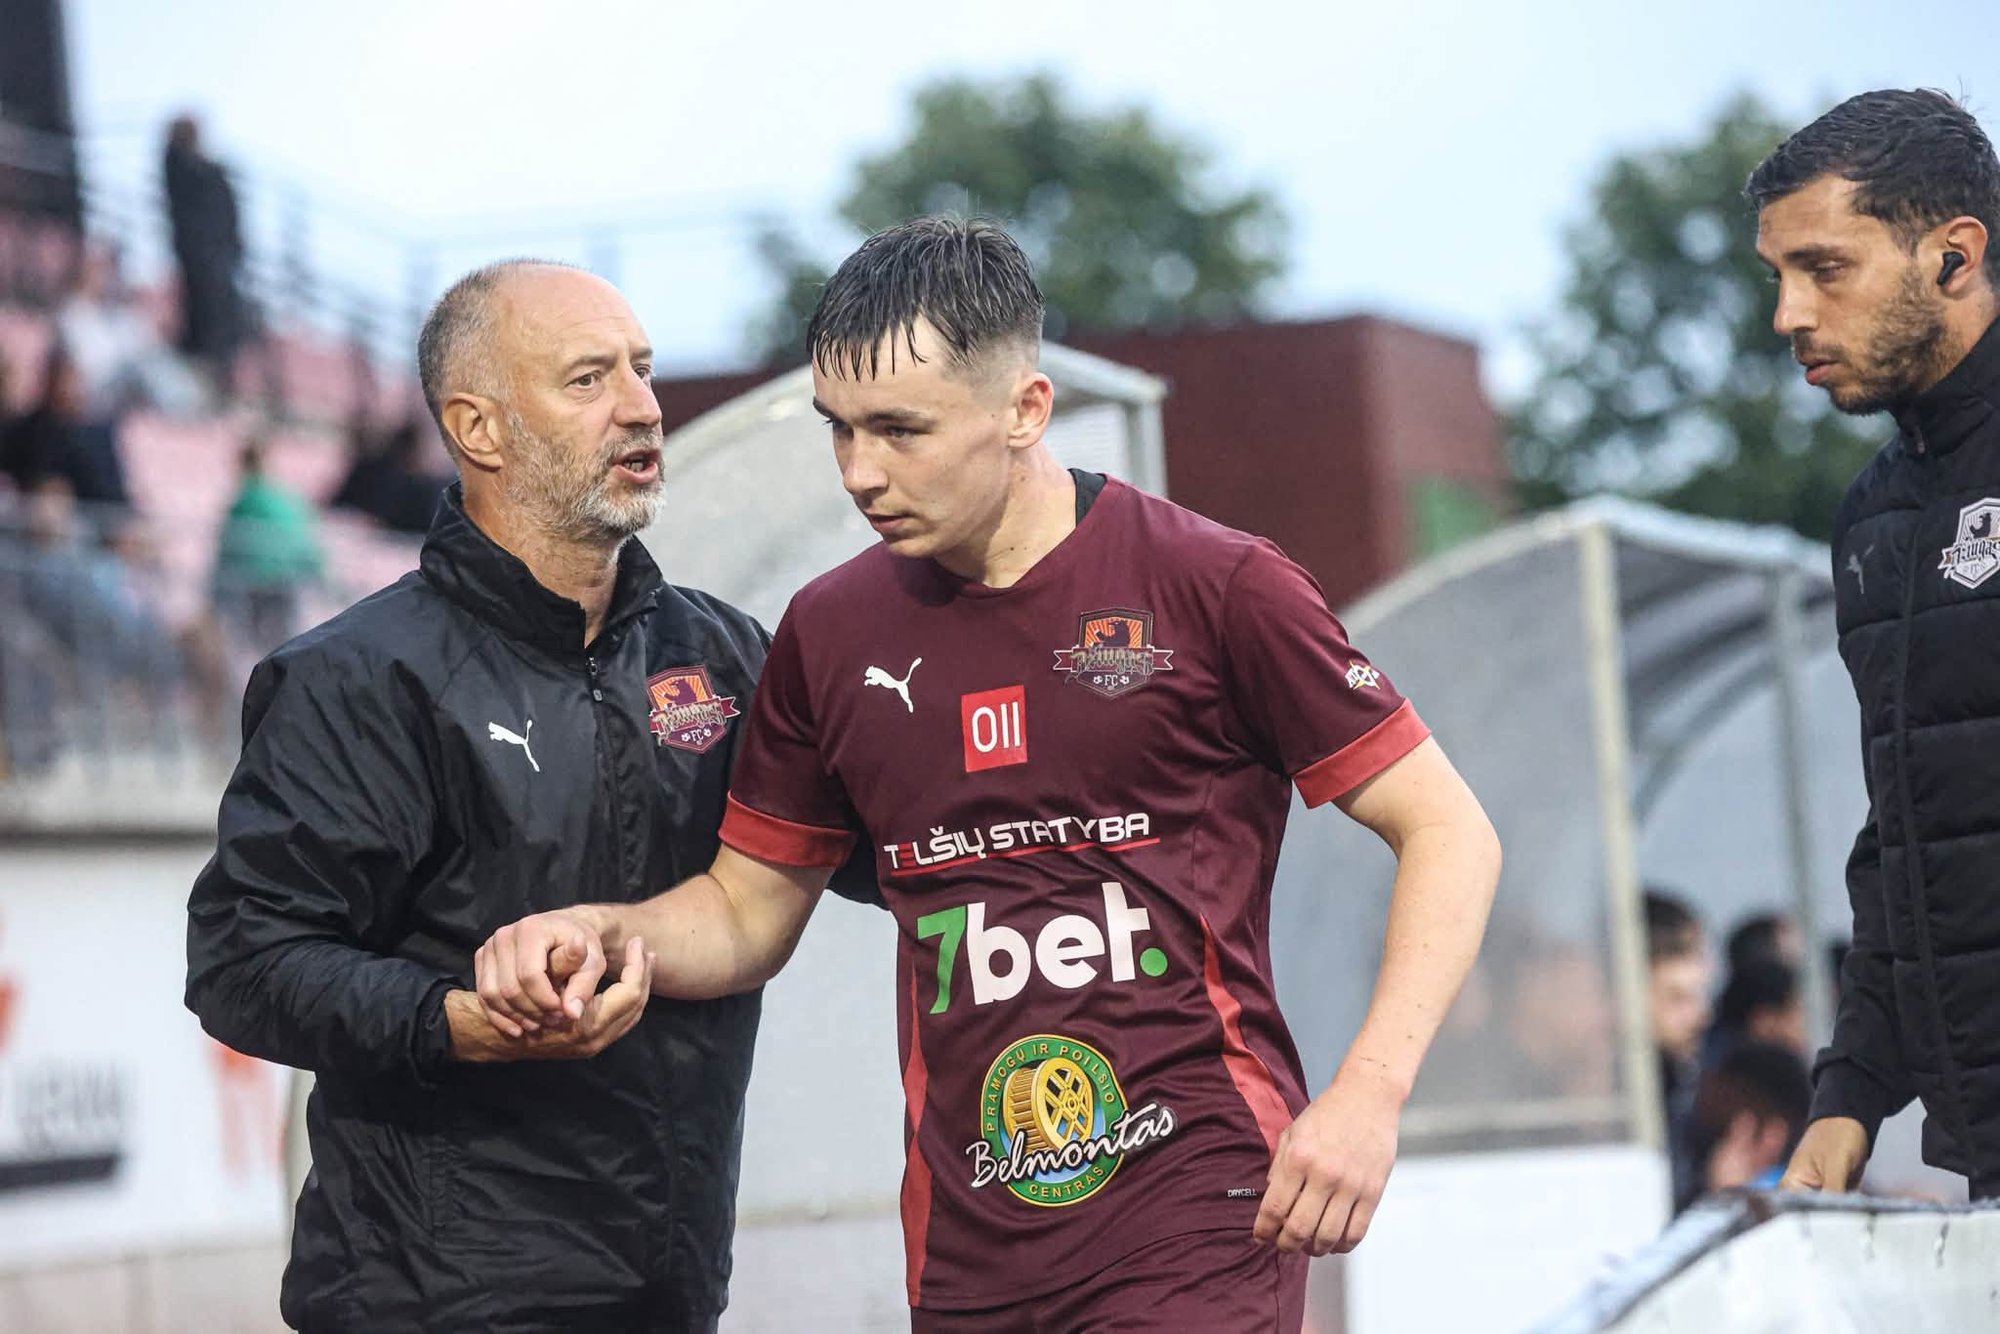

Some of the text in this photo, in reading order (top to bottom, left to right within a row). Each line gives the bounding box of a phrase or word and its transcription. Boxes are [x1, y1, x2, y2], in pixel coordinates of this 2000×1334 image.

[1104, 673, 1119, 687] FC
[690, 728, 704, 742] FC
[884, 812, 1150, 870] TELŠIŲ STATYBA
[986, 1043, 1116, 1132] PRAMOGŲ IR POILSIO
[965, 1103, 1174, 1188] Belmontas
[1029, 1165, 1105, 1199] CENTRAS
